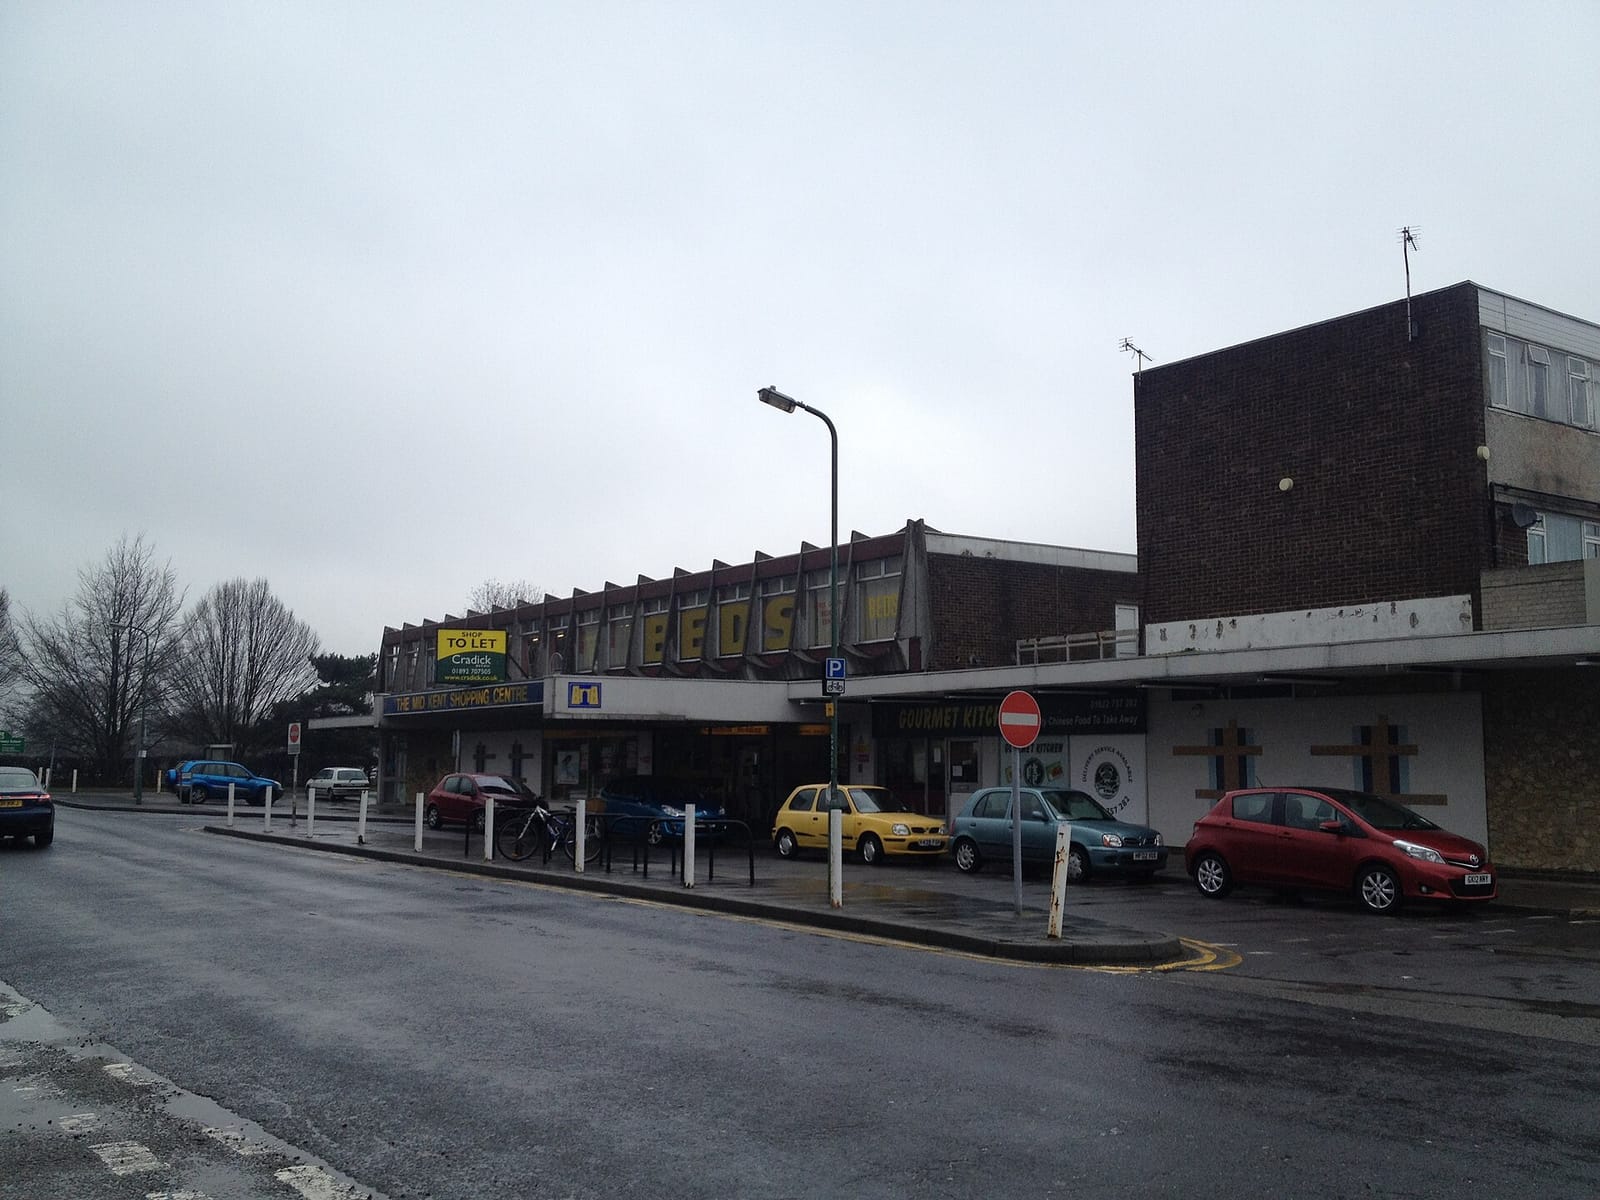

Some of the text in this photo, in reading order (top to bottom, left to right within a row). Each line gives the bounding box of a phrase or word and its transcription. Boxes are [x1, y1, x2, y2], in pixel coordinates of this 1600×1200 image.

[644, 596, 796, 663] BEDS
[446, 638, 497, 649] TO LET
[451, 654, 491, 665] Cradick
[829, 660, 843, 677] P
[396, 685, 529, 712] THE MID KENT SHOPPING CENTRE
[898, 706, 960, 729] GOURMET
[1074, 714, 1092, 726] Food
[1103, 713, 1118, 725] Take
[1119, 712, 1138, 728] Away
[1036, 743, 1064, 753] KITCHEN
[1094, 746, 1115, 754] SERVICE
